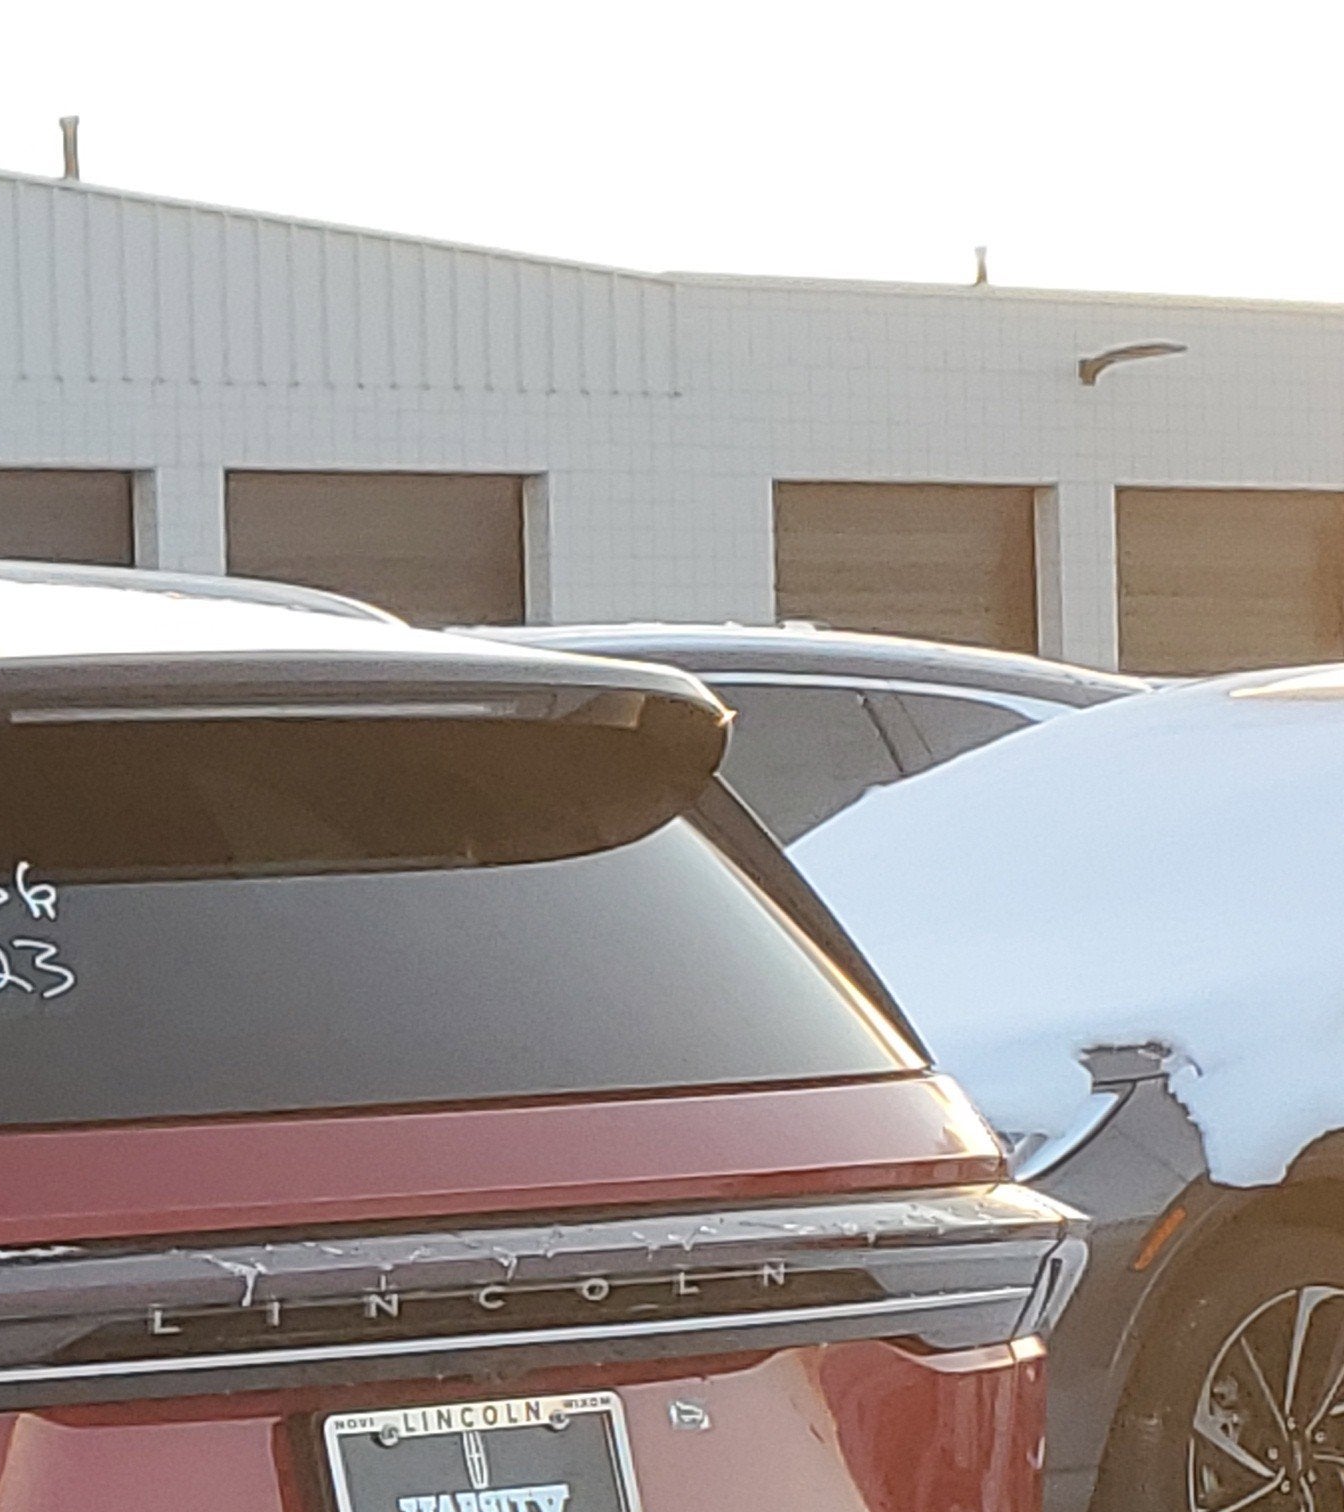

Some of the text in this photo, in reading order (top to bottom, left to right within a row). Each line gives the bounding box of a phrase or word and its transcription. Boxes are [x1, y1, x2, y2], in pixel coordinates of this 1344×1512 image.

[148, 1257, 787, 1336] LINCOLN
[334, 1416, 376, 1431] NOVI
[402, 1400, 542, 1433] LINCOLN
